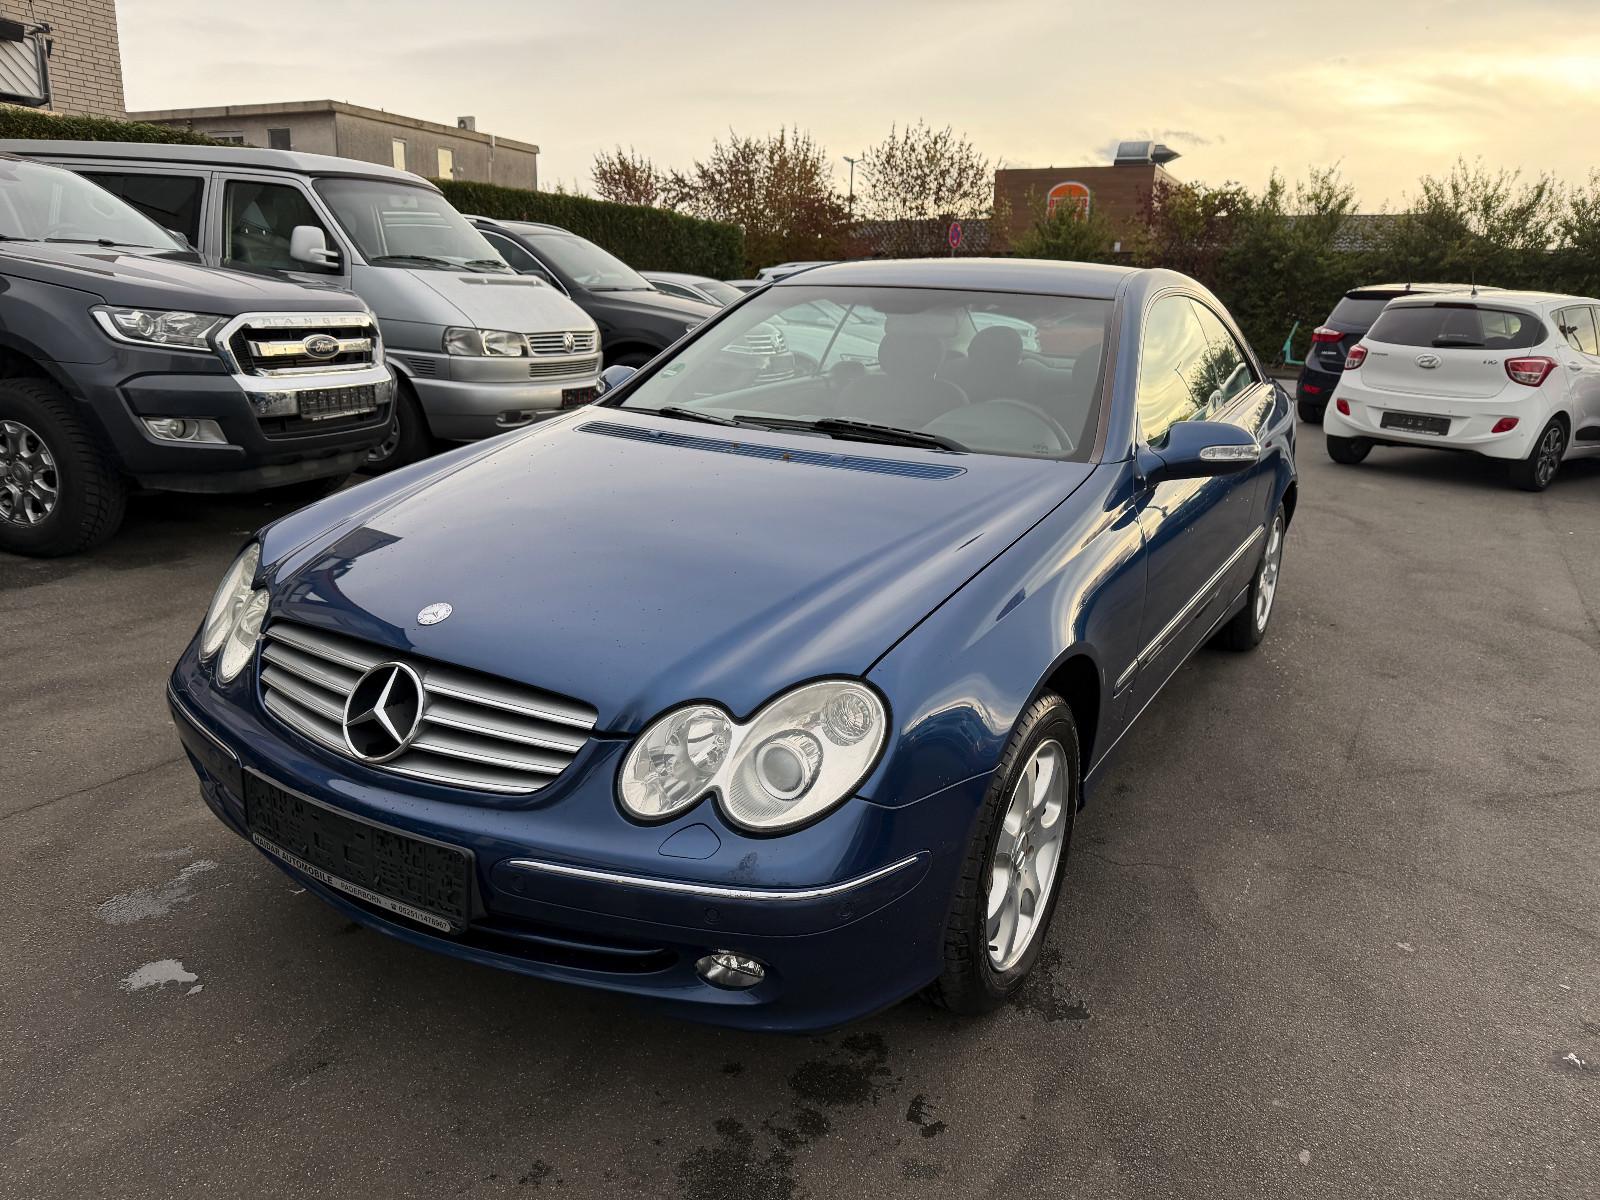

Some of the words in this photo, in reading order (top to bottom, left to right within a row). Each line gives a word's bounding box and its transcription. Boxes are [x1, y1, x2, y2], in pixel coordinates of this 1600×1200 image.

[262, 317, 366, 326] RANGER
[315, 340, 334, 352] Ford
[254, 835, 281, 856] HAIDAR
[281, 852, 334, 884] AUTOMOBILE
[340, 882, 382, 905] PADERBORN
